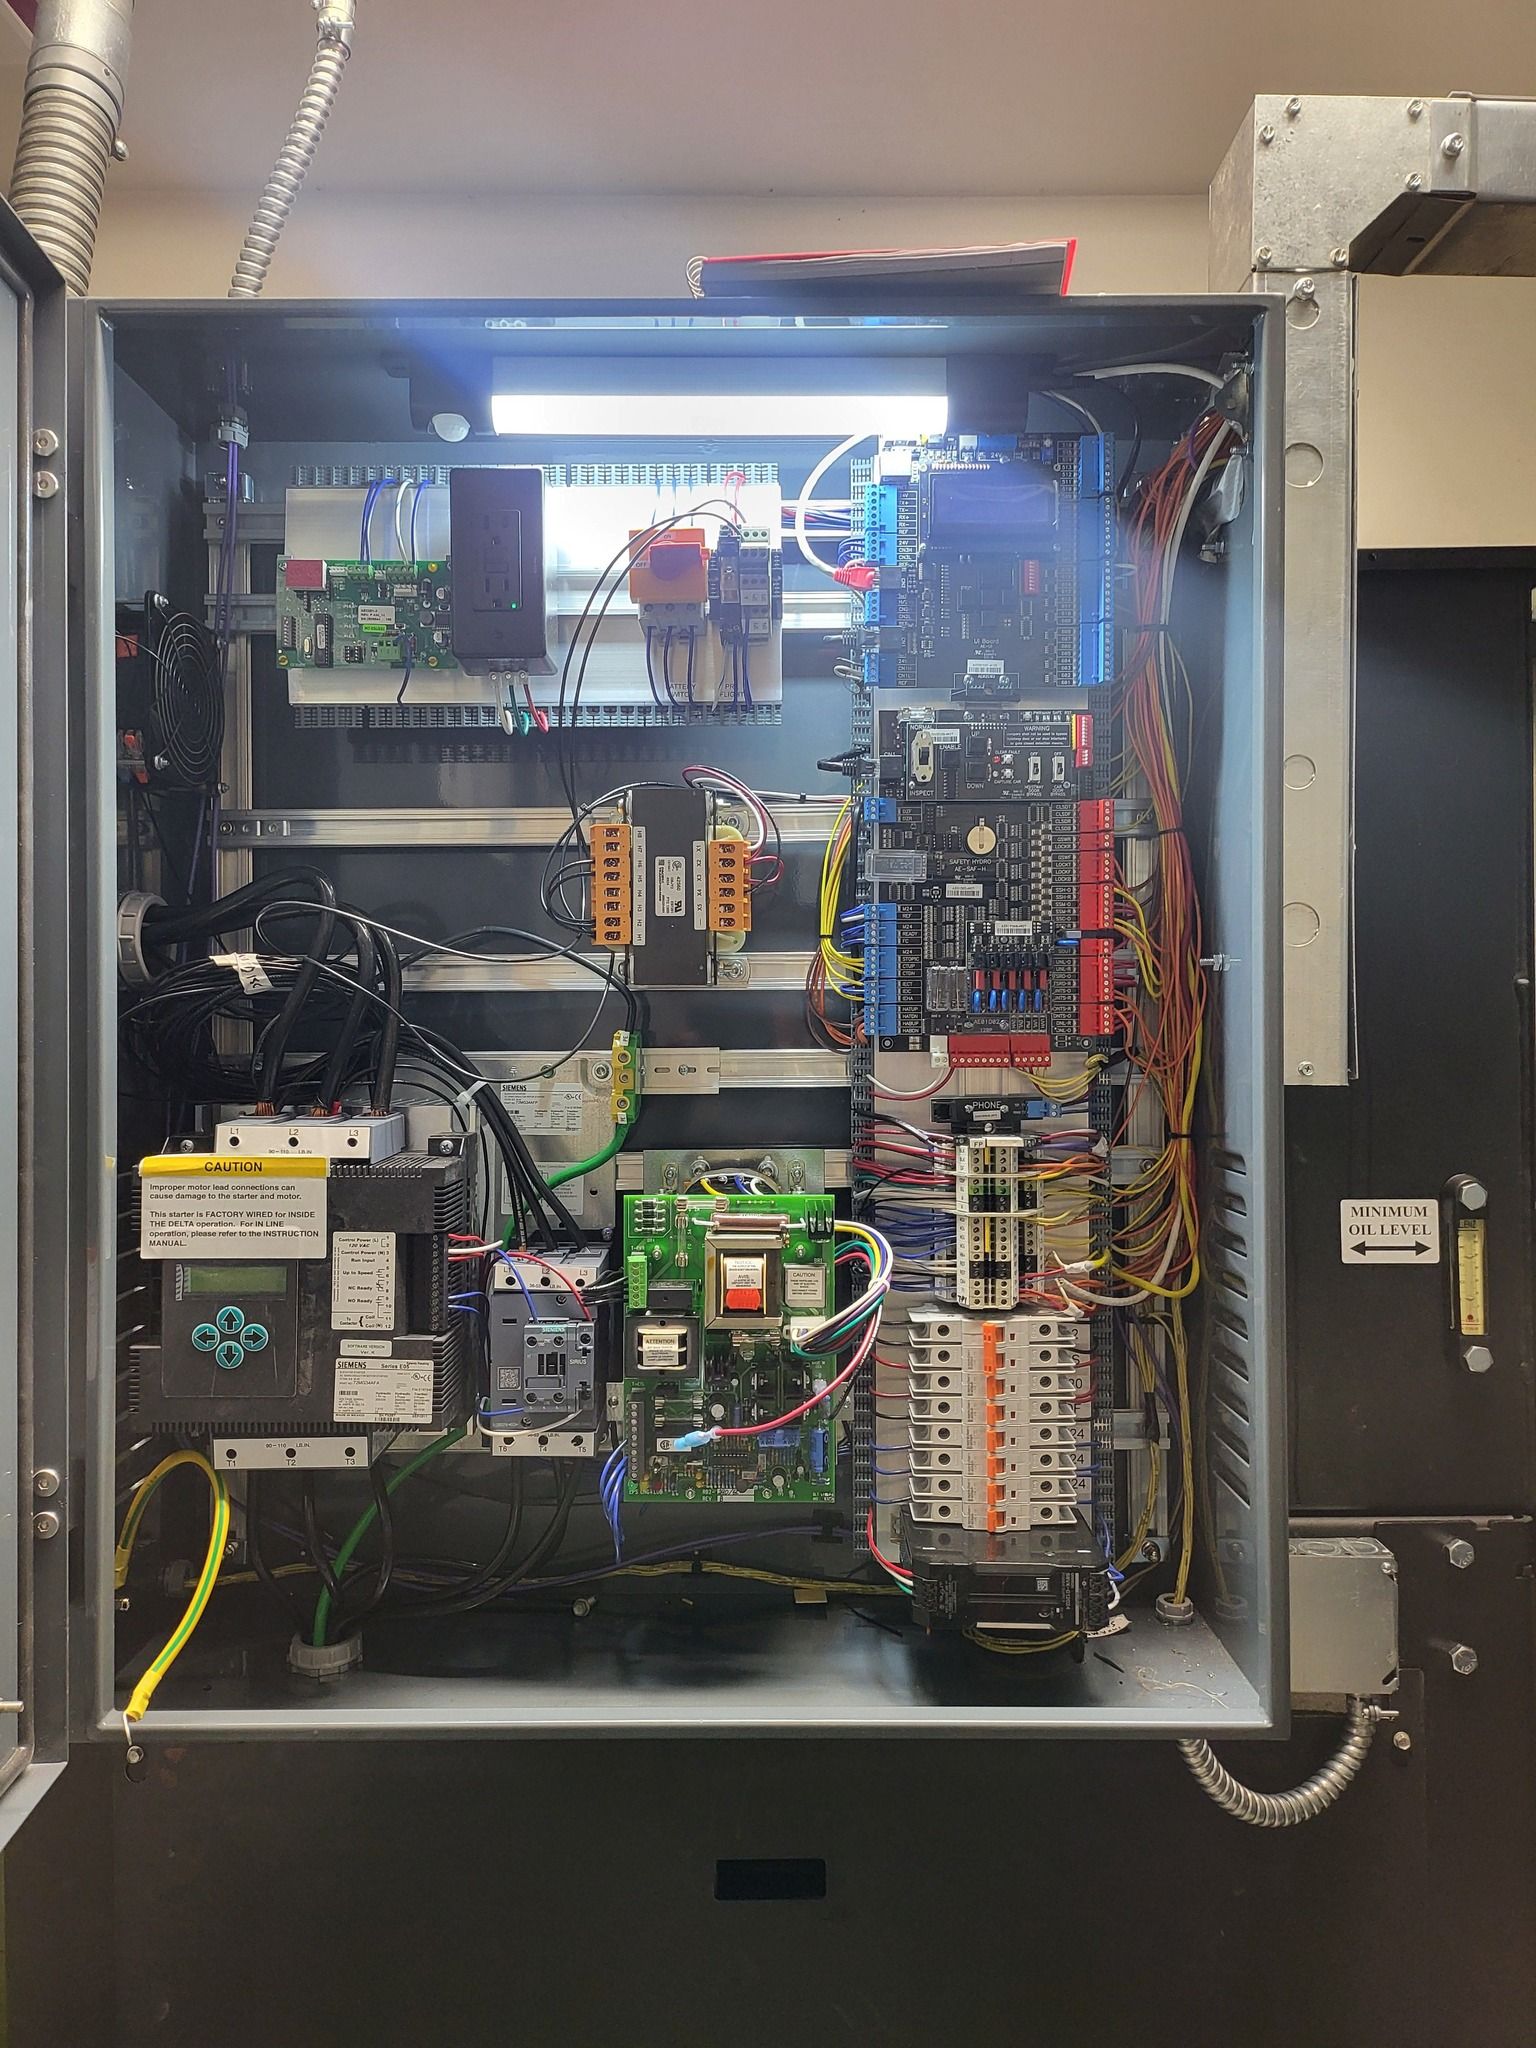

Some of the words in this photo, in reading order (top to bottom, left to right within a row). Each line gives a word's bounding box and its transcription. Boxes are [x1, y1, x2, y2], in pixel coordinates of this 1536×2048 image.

[205, 1162, 262, 1172] CAUTION
[1351, 1206, 1428, 1217] MINIMUM
[196, 1221, 235, 1229] operation.
[1349, 1224, 1376, 1235] OIL
[1380, 1224, 1432, 1235] LEVEL
[338, 1361, 367, 1369] SIEMENS
[345, 1458, 355, 1466] T3
